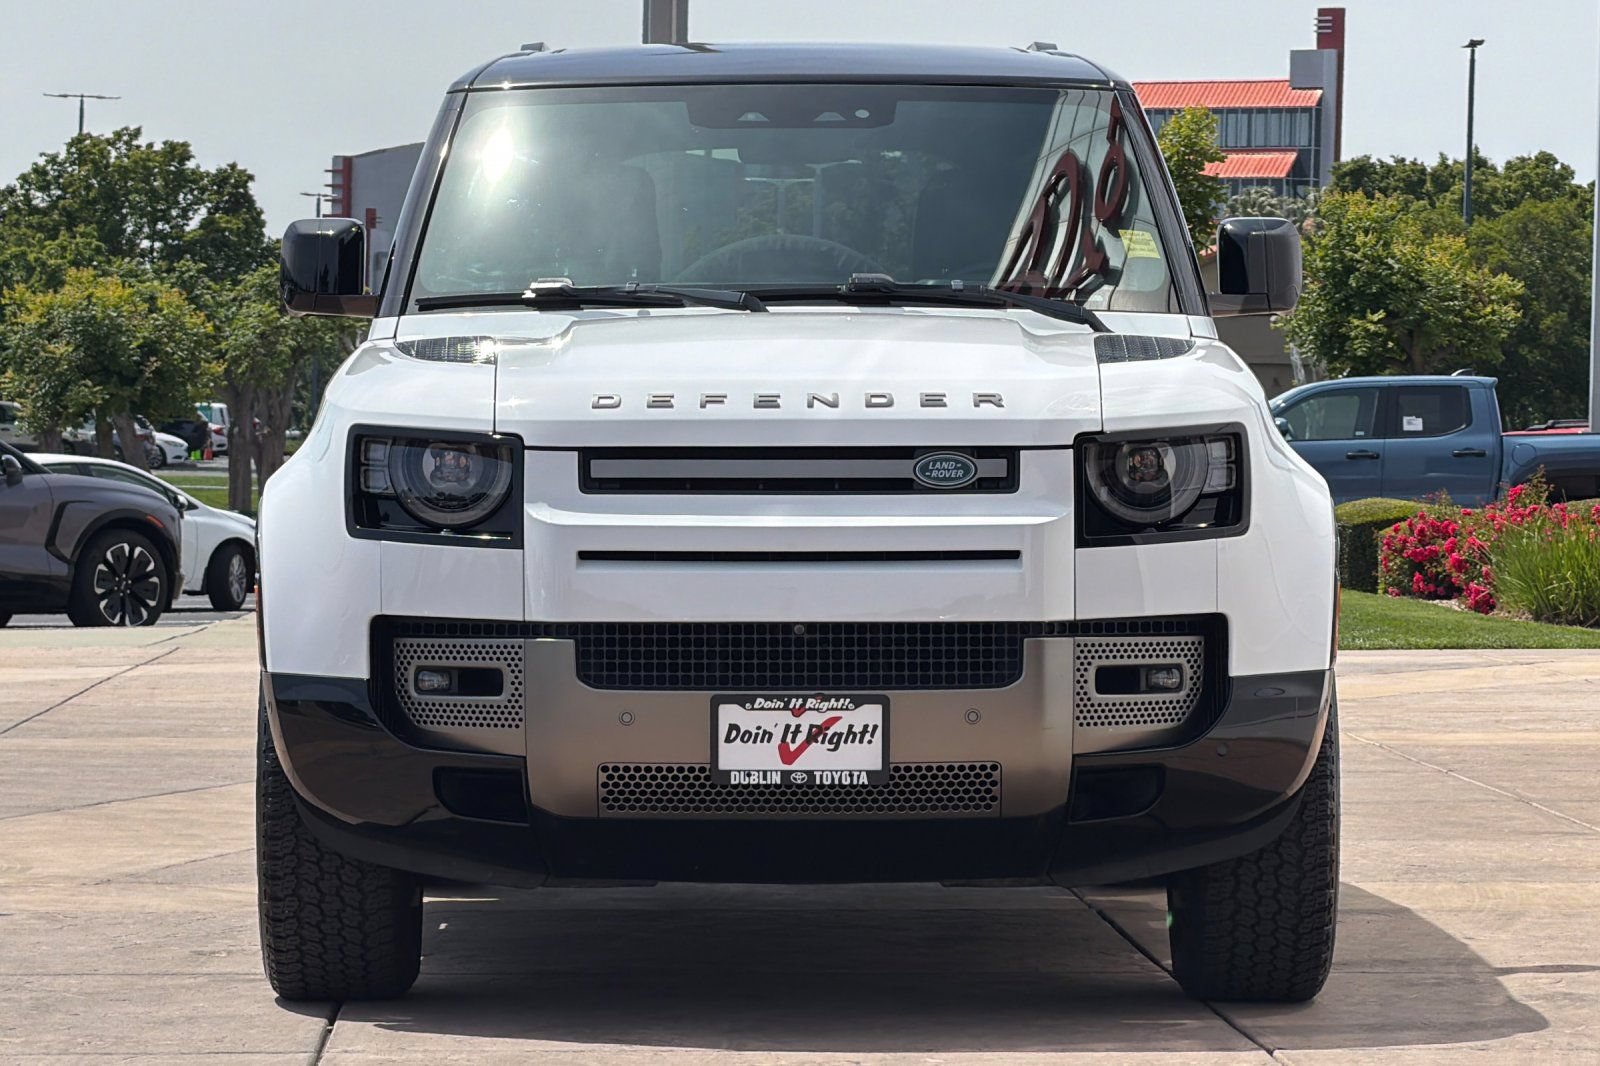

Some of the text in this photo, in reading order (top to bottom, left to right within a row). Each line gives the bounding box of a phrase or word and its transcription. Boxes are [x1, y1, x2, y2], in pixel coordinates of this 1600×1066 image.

[591, 392, 1006, 409] DEFENDER
[753, 697, 851, 713] Doin' It Right!
[724, 722, 879, 752] Doin' It Right!
[730, 771, 869, 785] DUBLIN TOYOTA
